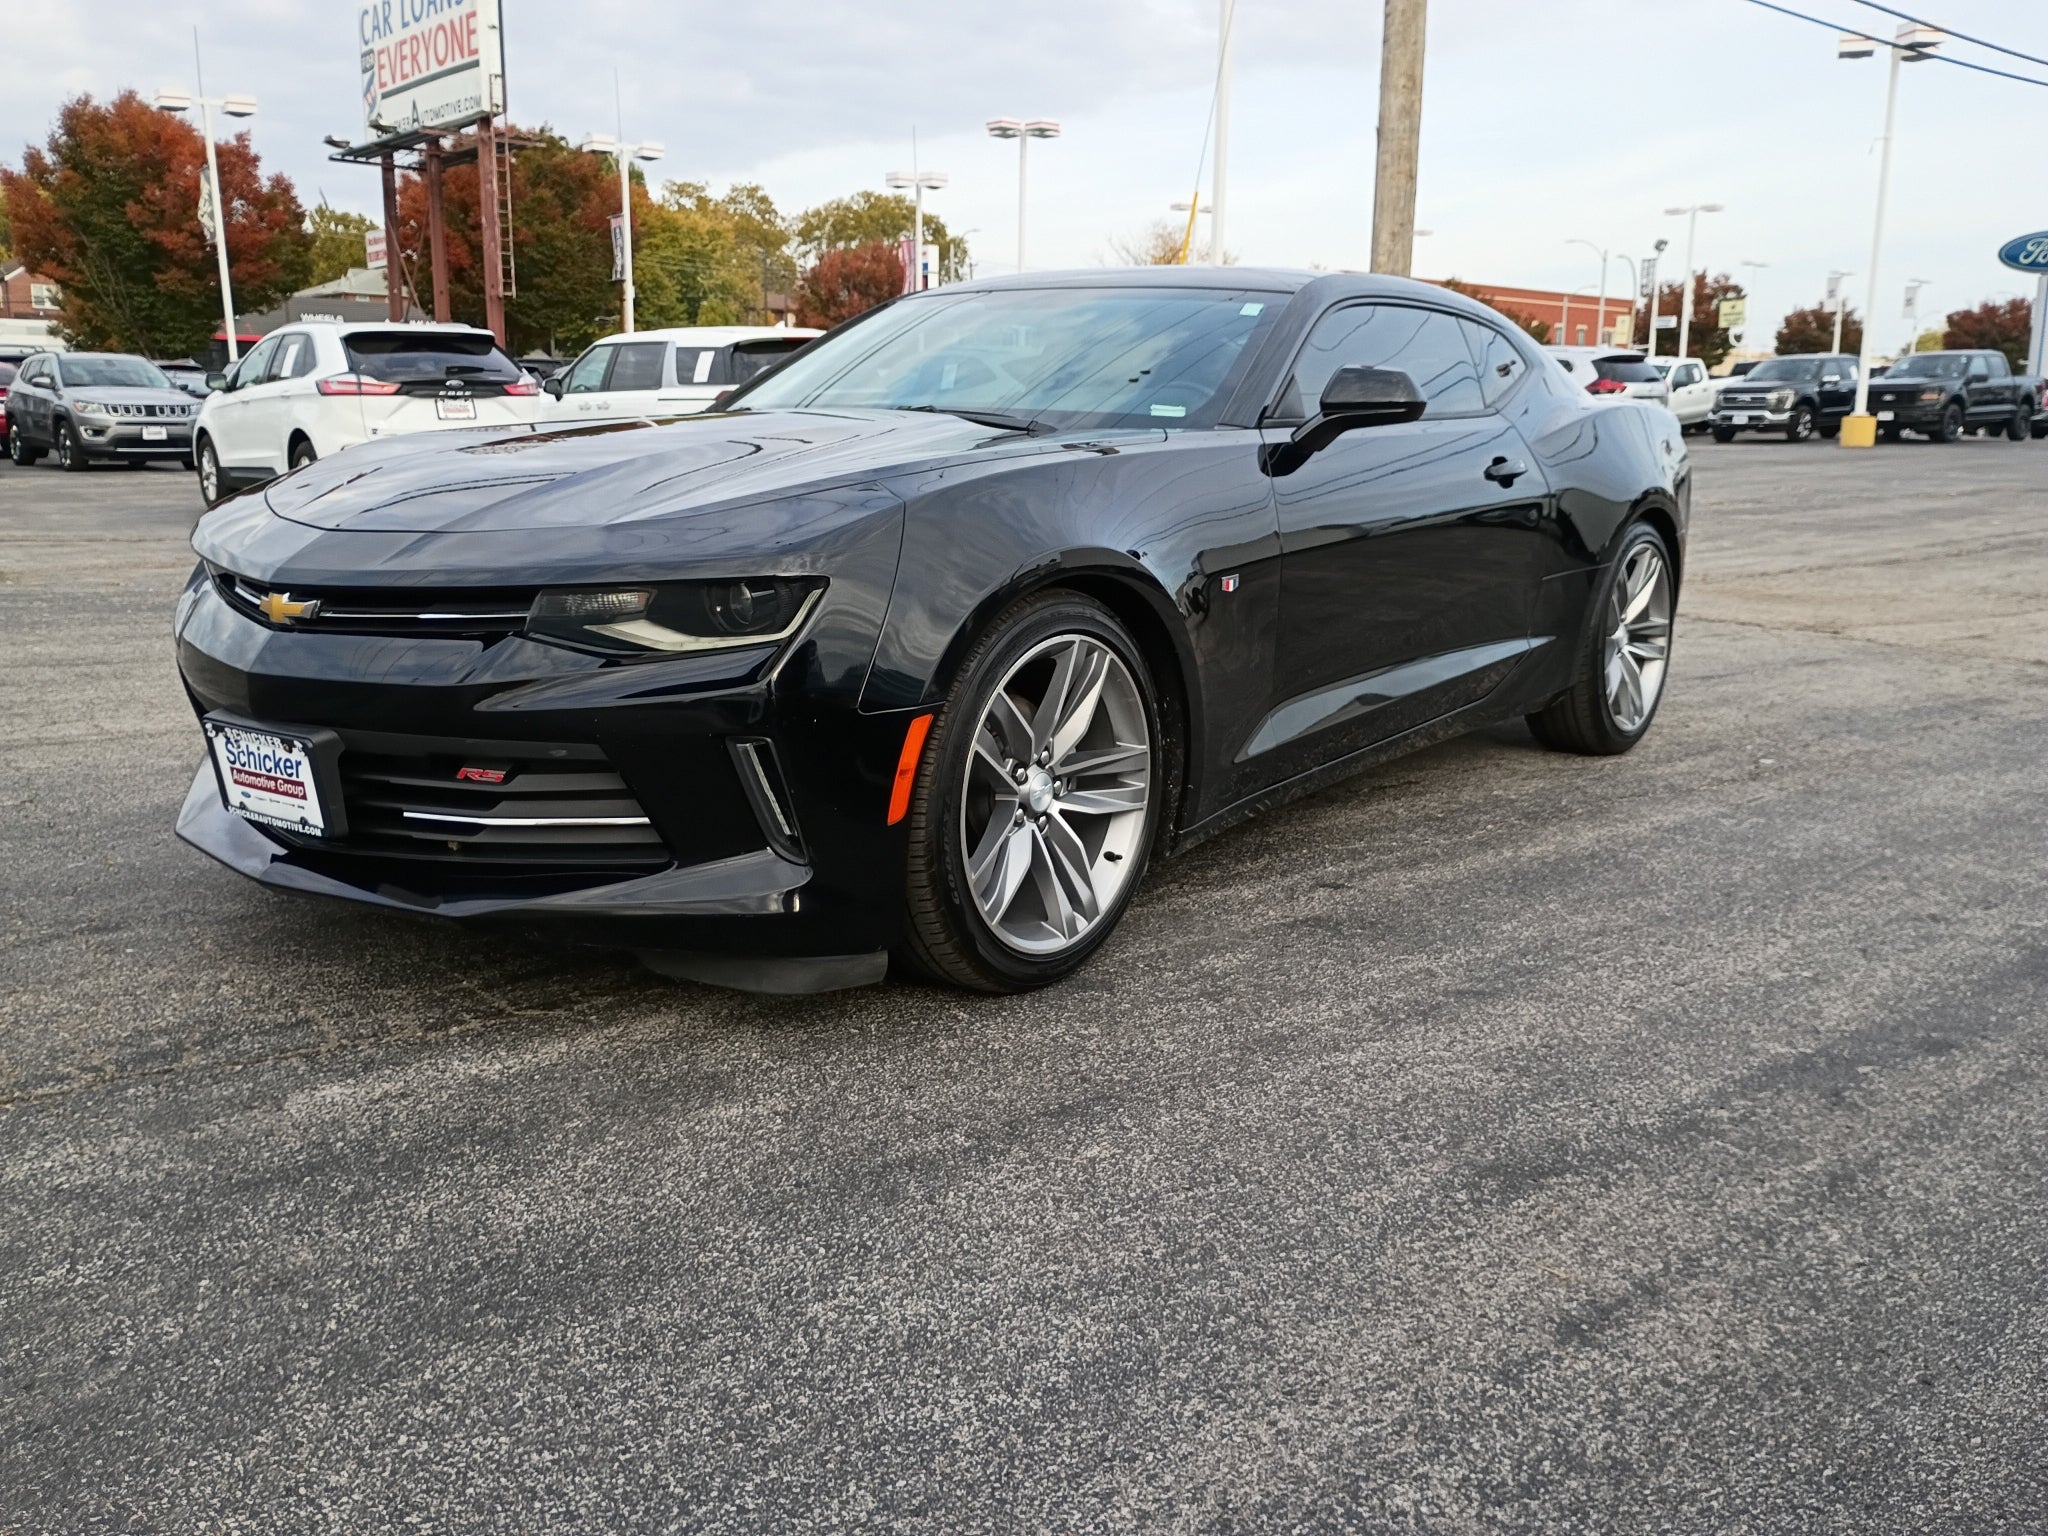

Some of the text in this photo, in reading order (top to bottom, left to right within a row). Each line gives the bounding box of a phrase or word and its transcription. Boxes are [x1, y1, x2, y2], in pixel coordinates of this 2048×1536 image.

[361, 0, 393, 46] CAR
[377, 10, 479, 89] EVERYONE
[2019, 237, 2048, 265] Fo
[225, 740, 302, 778] Schicker
[457, 767, 507, 783] RS
[233, 769, 304, 797] Automotive Group
